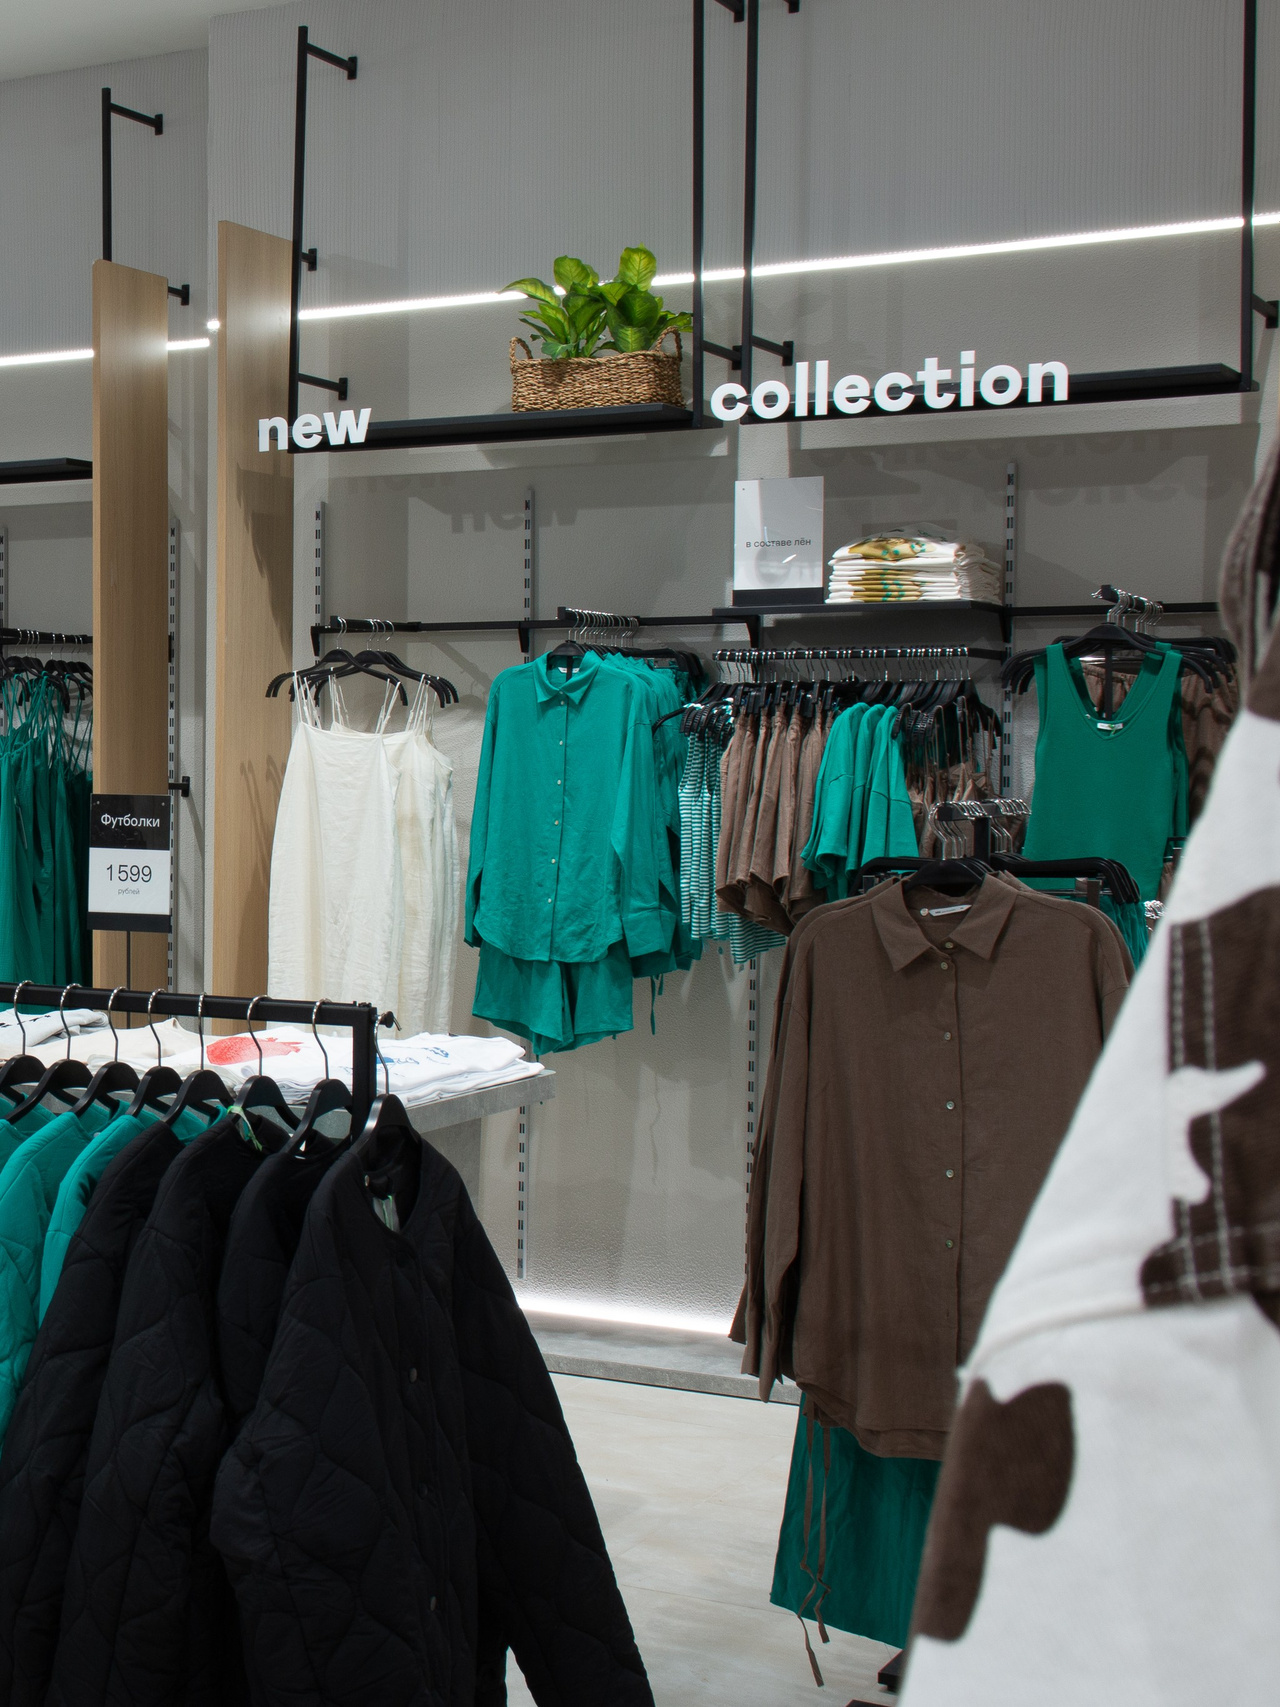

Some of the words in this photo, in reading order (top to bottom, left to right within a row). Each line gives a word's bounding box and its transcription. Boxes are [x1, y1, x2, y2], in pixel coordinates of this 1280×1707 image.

[258, 408, 372, 452] new
[710, 350, 1068, 421] collection
[753, 539, 792, 548] составе
[794, 537, 812, 546] лён
[100, 813, 160, 829] Футболки
[106, 864, 152, 883] 1599
